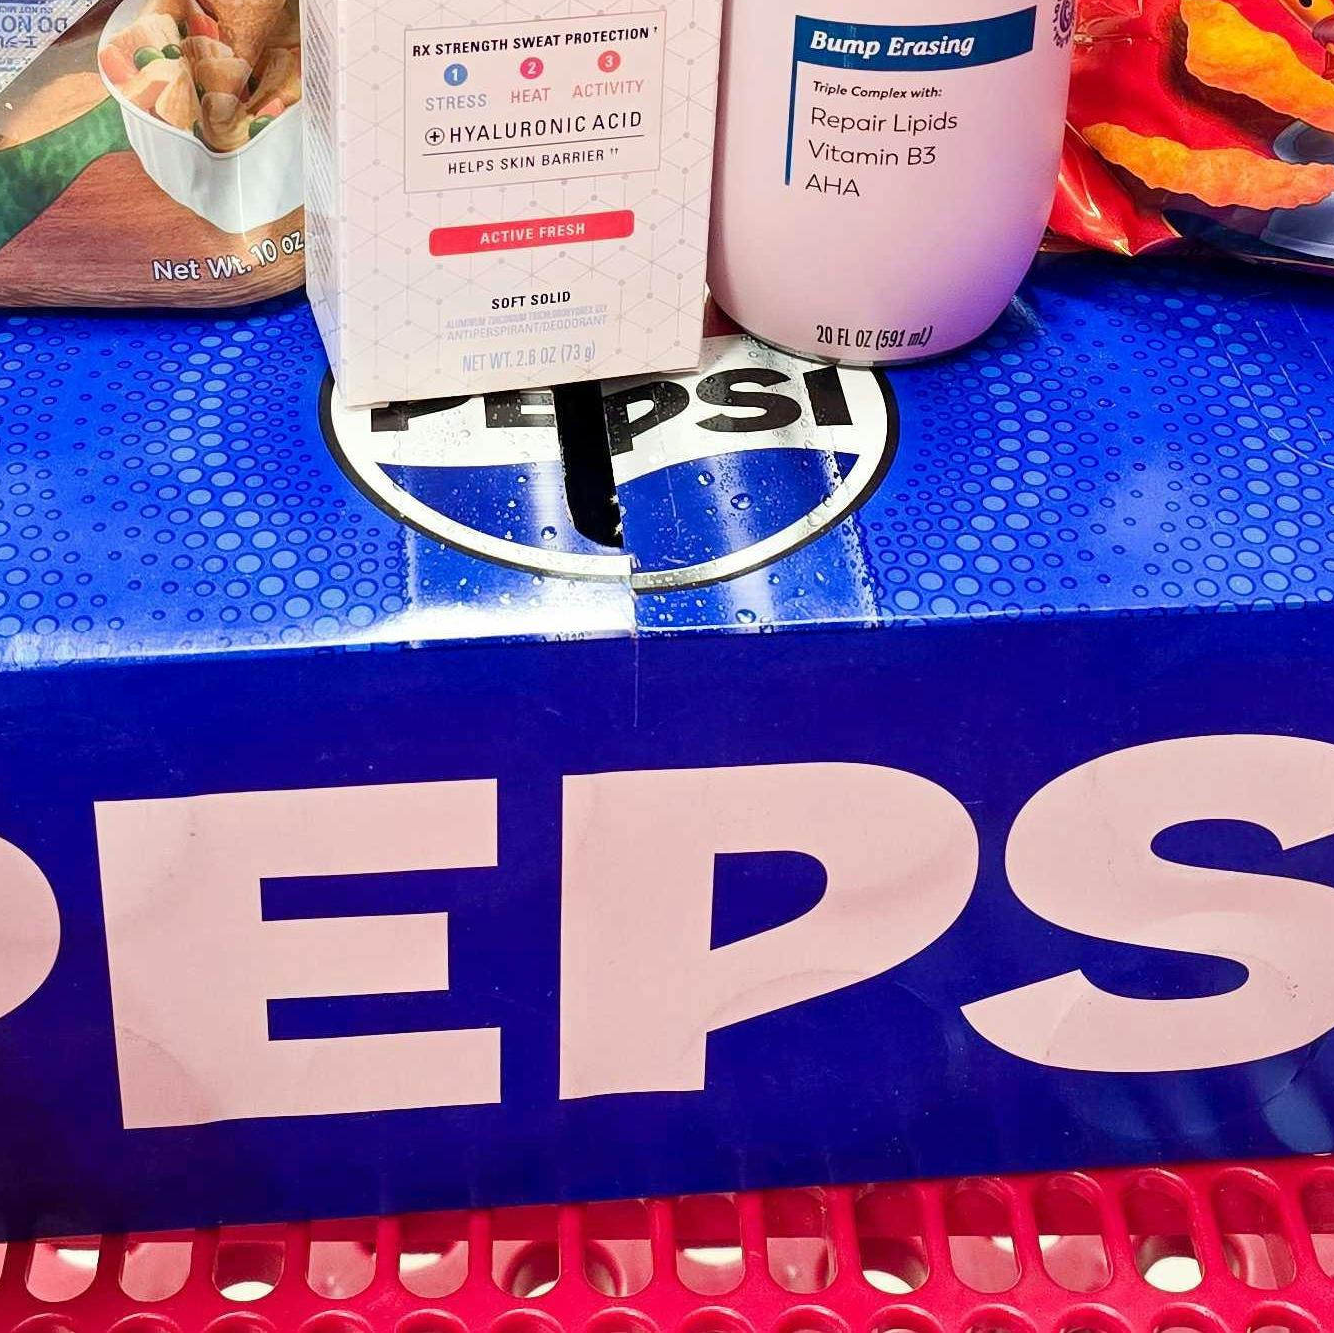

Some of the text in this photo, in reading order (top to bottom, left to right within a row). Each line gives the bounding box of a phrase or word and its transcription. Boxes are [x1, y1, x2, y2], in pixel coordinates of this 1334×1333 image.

[37, 16, 67, 33] DO
[412, 44, 432, 57] RX
[435, 38, 508, 55] STRENGTH
[513, 34, 560, 50] SWEAT
[810, 30, 975, 59] Bump Erasing
[425, 79, 645, 111] STRESS HEAT ACTIVITY
[813, 80, 943, 101] Triple Complex with:
[450, 111, 642, 143] HYALURONIC ACID
[811, 107, 958, 136] Repair Lipids
[448, 159, 494, 175] HELPS
[500, 154, 535, 170] SKIN
[808, 139, 936, 166] Vitamin B3
[805, 173, 860, 197] AHA
[479, 222, 585, 246] ACTIVE FRESH
[152, 231, 304, 280] Net Wt. 10 oz
[491, 291, 571, 310] SOFT SOLID
[816, 324, 832, 344] 20
[837, 327, 852, 346] FL
[855, 329, 872, 348] OZ
[876, 327, 905, 351] (591
[462, 354, 486, 372] NET
[489, 351, 513, 370] WT.
[540, 346, 556, 364] OZ
[561, 343, 580, 363] (73
